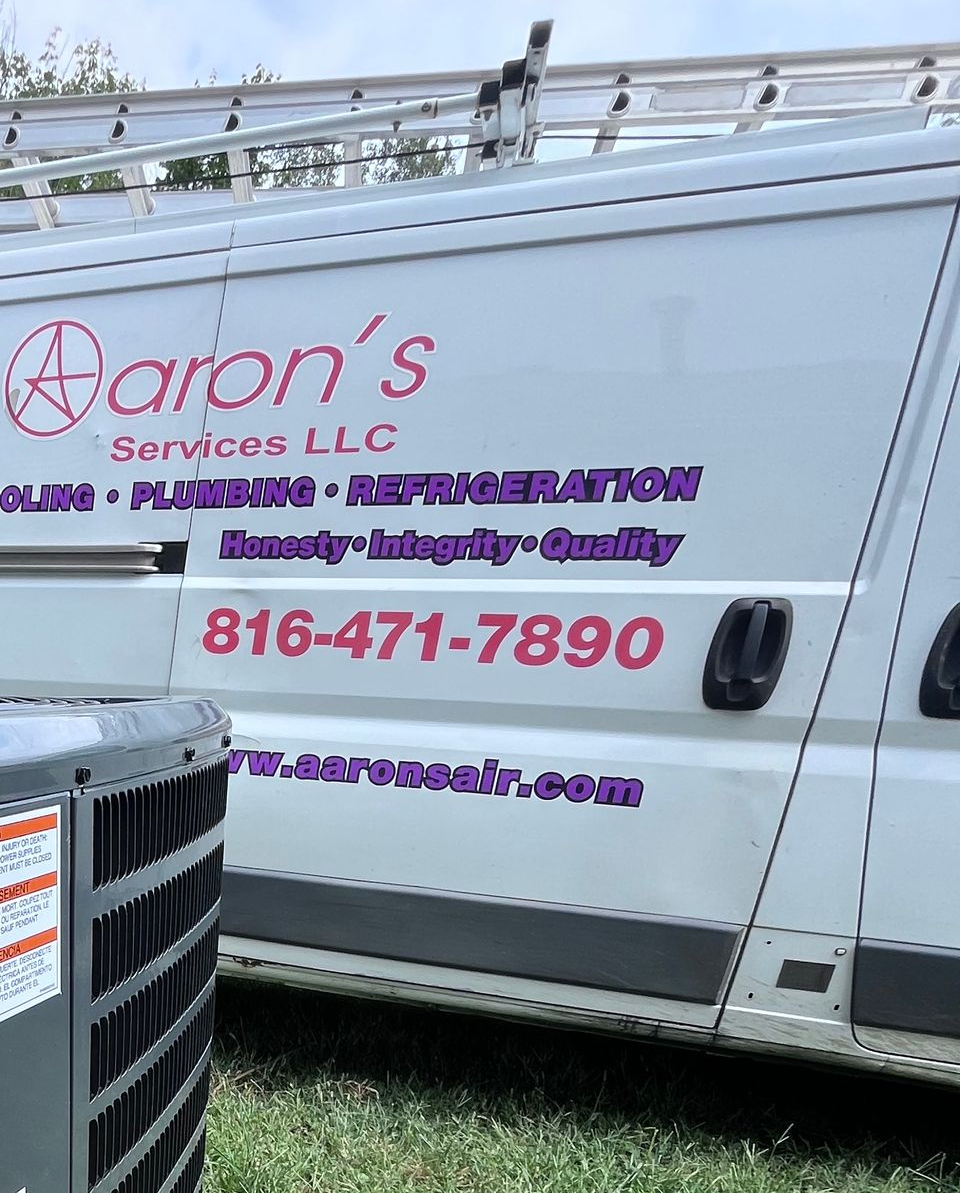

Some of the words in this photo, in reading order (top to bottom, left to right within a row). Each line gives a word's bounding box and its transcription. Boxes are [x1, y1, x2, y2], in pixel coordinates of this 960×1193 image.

[110, 430, 288, 462] Services
[304, 423, 399, 455] LLC
[130, 474, 316, 510] PLUMBING
[345, 466, 704, 506] REFRIGERATION
[219, 530, 354, 565] Honesty
[366, 528, 523, 566] Integrity
[539, 528, 685, 567] Quality
[202, 608, 665, 669] 816-471-7890
[2, 841, 20, 852] INJURY
[21, 838, 29, 847] OR
[17, 845, 42, 858] SUPPLIES
